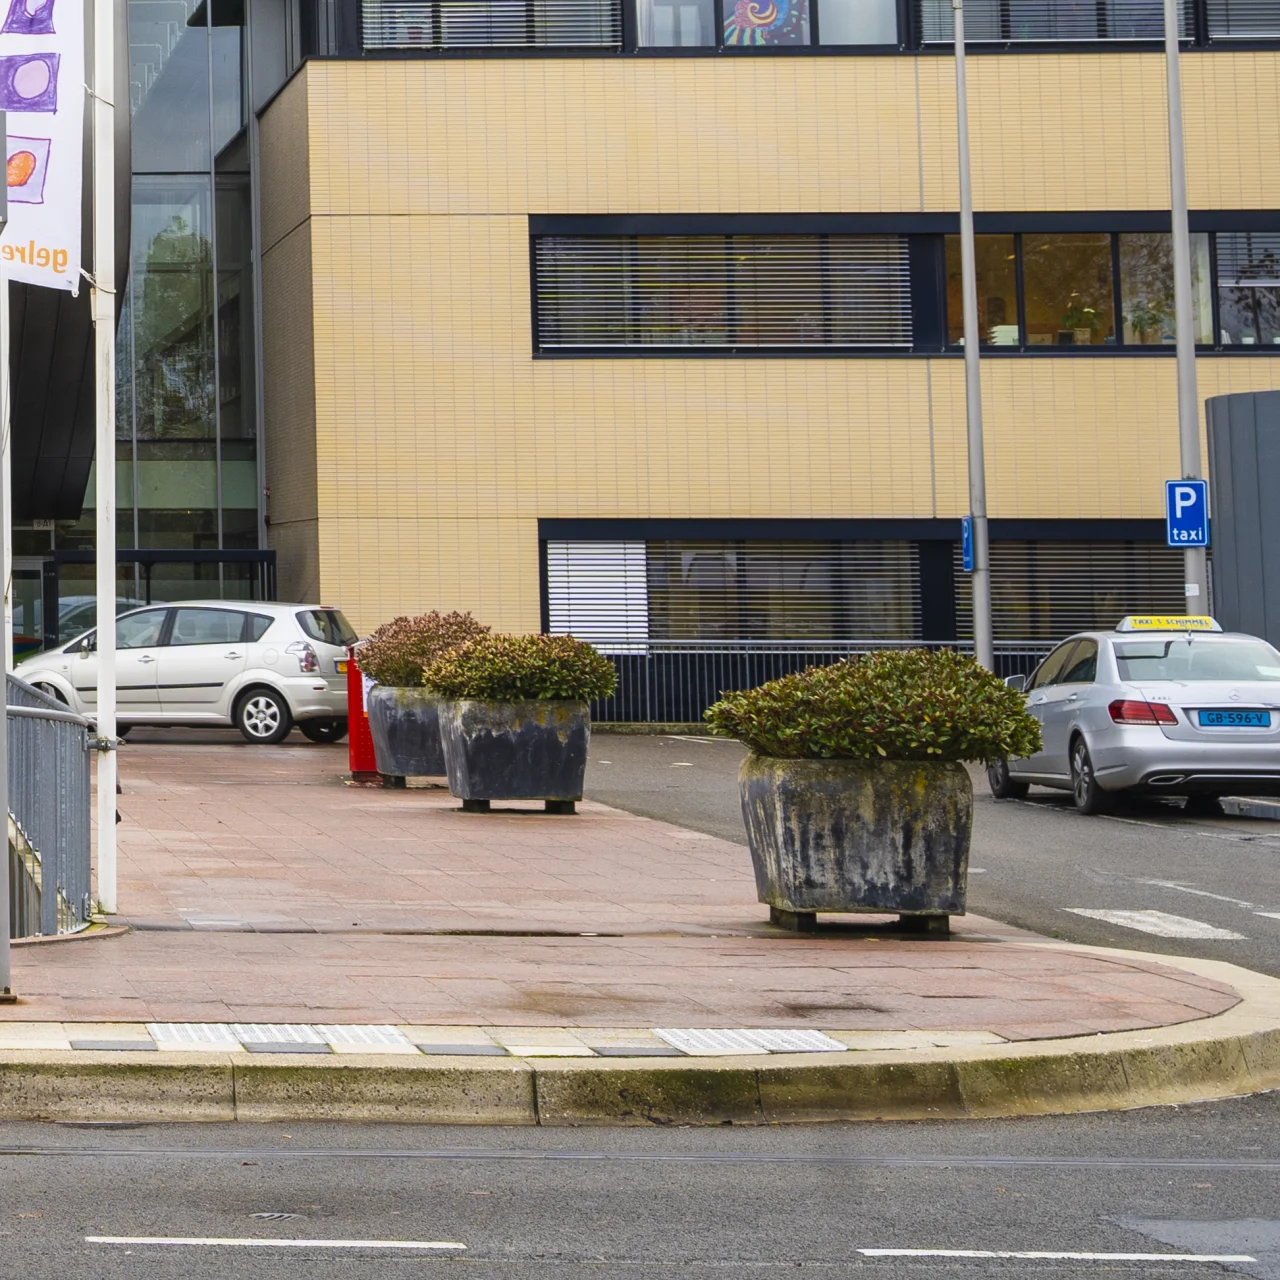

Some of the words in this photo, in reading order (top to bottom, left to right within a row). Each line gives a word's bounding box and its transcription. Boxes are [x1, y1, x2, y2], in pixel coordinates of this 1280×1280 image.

[1174, 486, 1197, 519] P
[1172, 527, 1203, 541] taxi
[1133, 618, 1153, 626] TAXI
